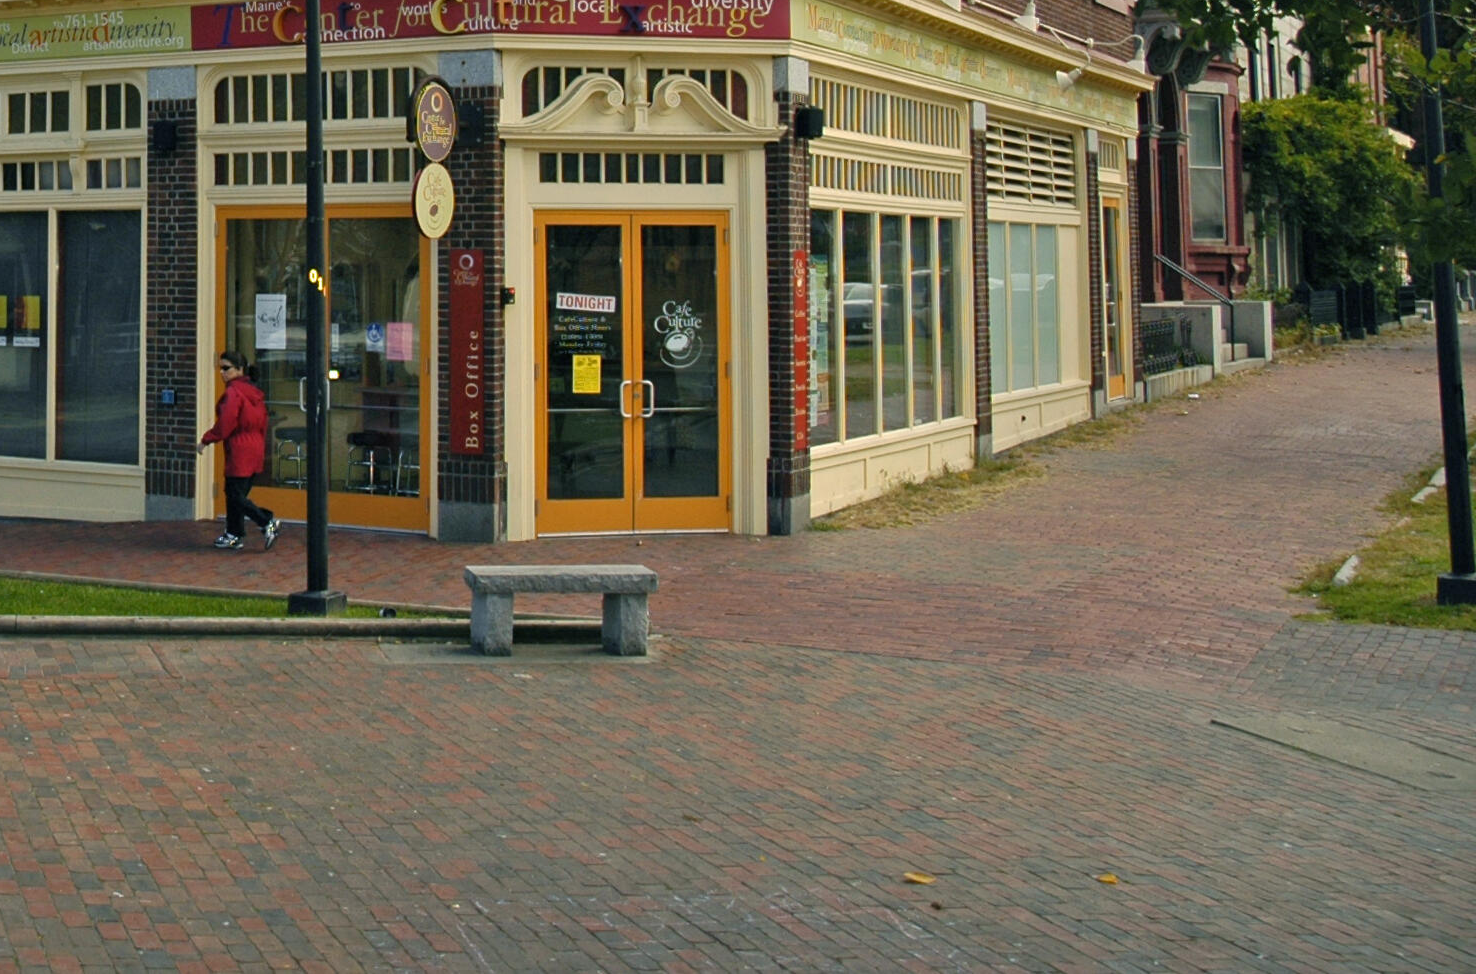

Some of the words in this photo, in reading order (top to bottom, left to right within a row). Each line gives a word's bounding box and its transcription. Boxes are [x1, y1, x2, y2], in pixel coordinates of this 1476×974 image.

[245, 0, 292, 13] Maine's
[64, 11, 124, 28] 761-1545
[213, 4, 269, 48] The
[273, 2, 384, 43] Cnter
[641, 18, 693, 34] artistic
[83, 36, 184, 52] artsandculture.org
[558, 294, 613, 311] TONIGHT
[654, 315, 703, 334] Culture
[465, 330, 479, 399] Office
[465, 411, 479, 449] Box
